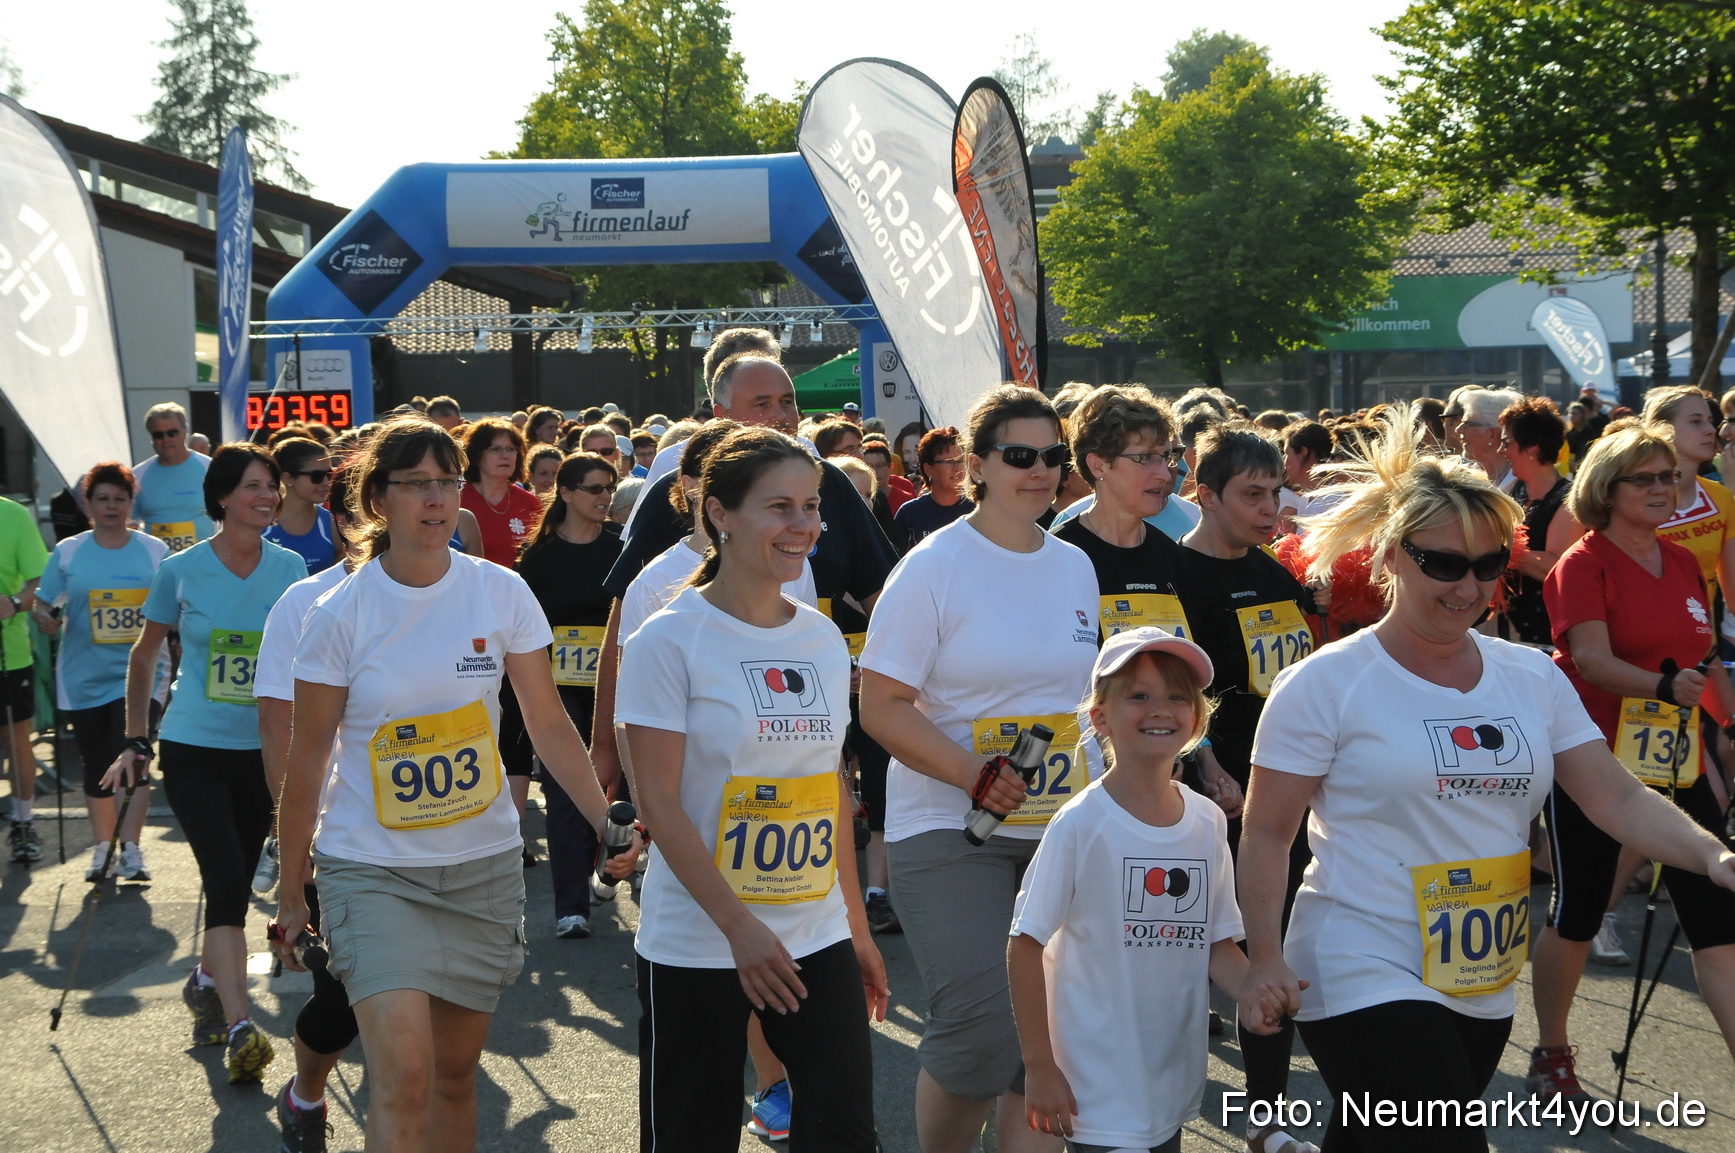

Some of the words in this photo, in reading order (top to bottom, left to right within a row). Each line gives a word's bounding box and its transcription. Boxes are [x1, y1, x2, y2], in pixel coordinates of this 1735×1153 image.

[602, 189, 641, 198] Fischer
[573, 208, 691, 232] firmenlauf
[573, 233, 621, 241] neumarkt
[342, 253, 407, 268] Fischer
[1692, 519, 1727, 538] BÖGL
[162, 536, 195, 552] 385
[556, 647, 600, 671] 112
[1250, 630, 1311, 674] 1126
[757, 719, 833, 734] POLGER
[390, 733, 436, 749] firmenlauf
[378, 751, 415, 762] walken
[391, 748, 481, 803] 903
[1024, 753, 1071, 797] 02
[1437, 778, 1531, 793] POLGER
[418, 802, 447, 810] Stefanie
[447, 795, 467, 806] Zeuch
[1437, 790, 1529, 800] TRANSPORT
[400, 813, 438, 822] Neumarkter
[440, 803, 473, 817] Lammsbräu
[474, 799, 484, 807] KG
[744, 798, 793, 809] firmenlauf
[729, 811, 769, 822] walken
[724, 818, 833, 872] 1003
[756, 875, 783, 883] Bettina
[784, 875, 804, 883] Niebler
[742, 885, 764, 893] Polger
[766, 886, 796, 894] Transport
[796, 884, 812, 892] GmbH
[1440, 880, 1492, 895] firmenlauf
[1427, 900, 1470, 913] walken
[1124, 924, 1206, 941] POLGER
[1428, 895, 1529, 964] 1002
[1460, 964, 1496, 974] Sieglinde
